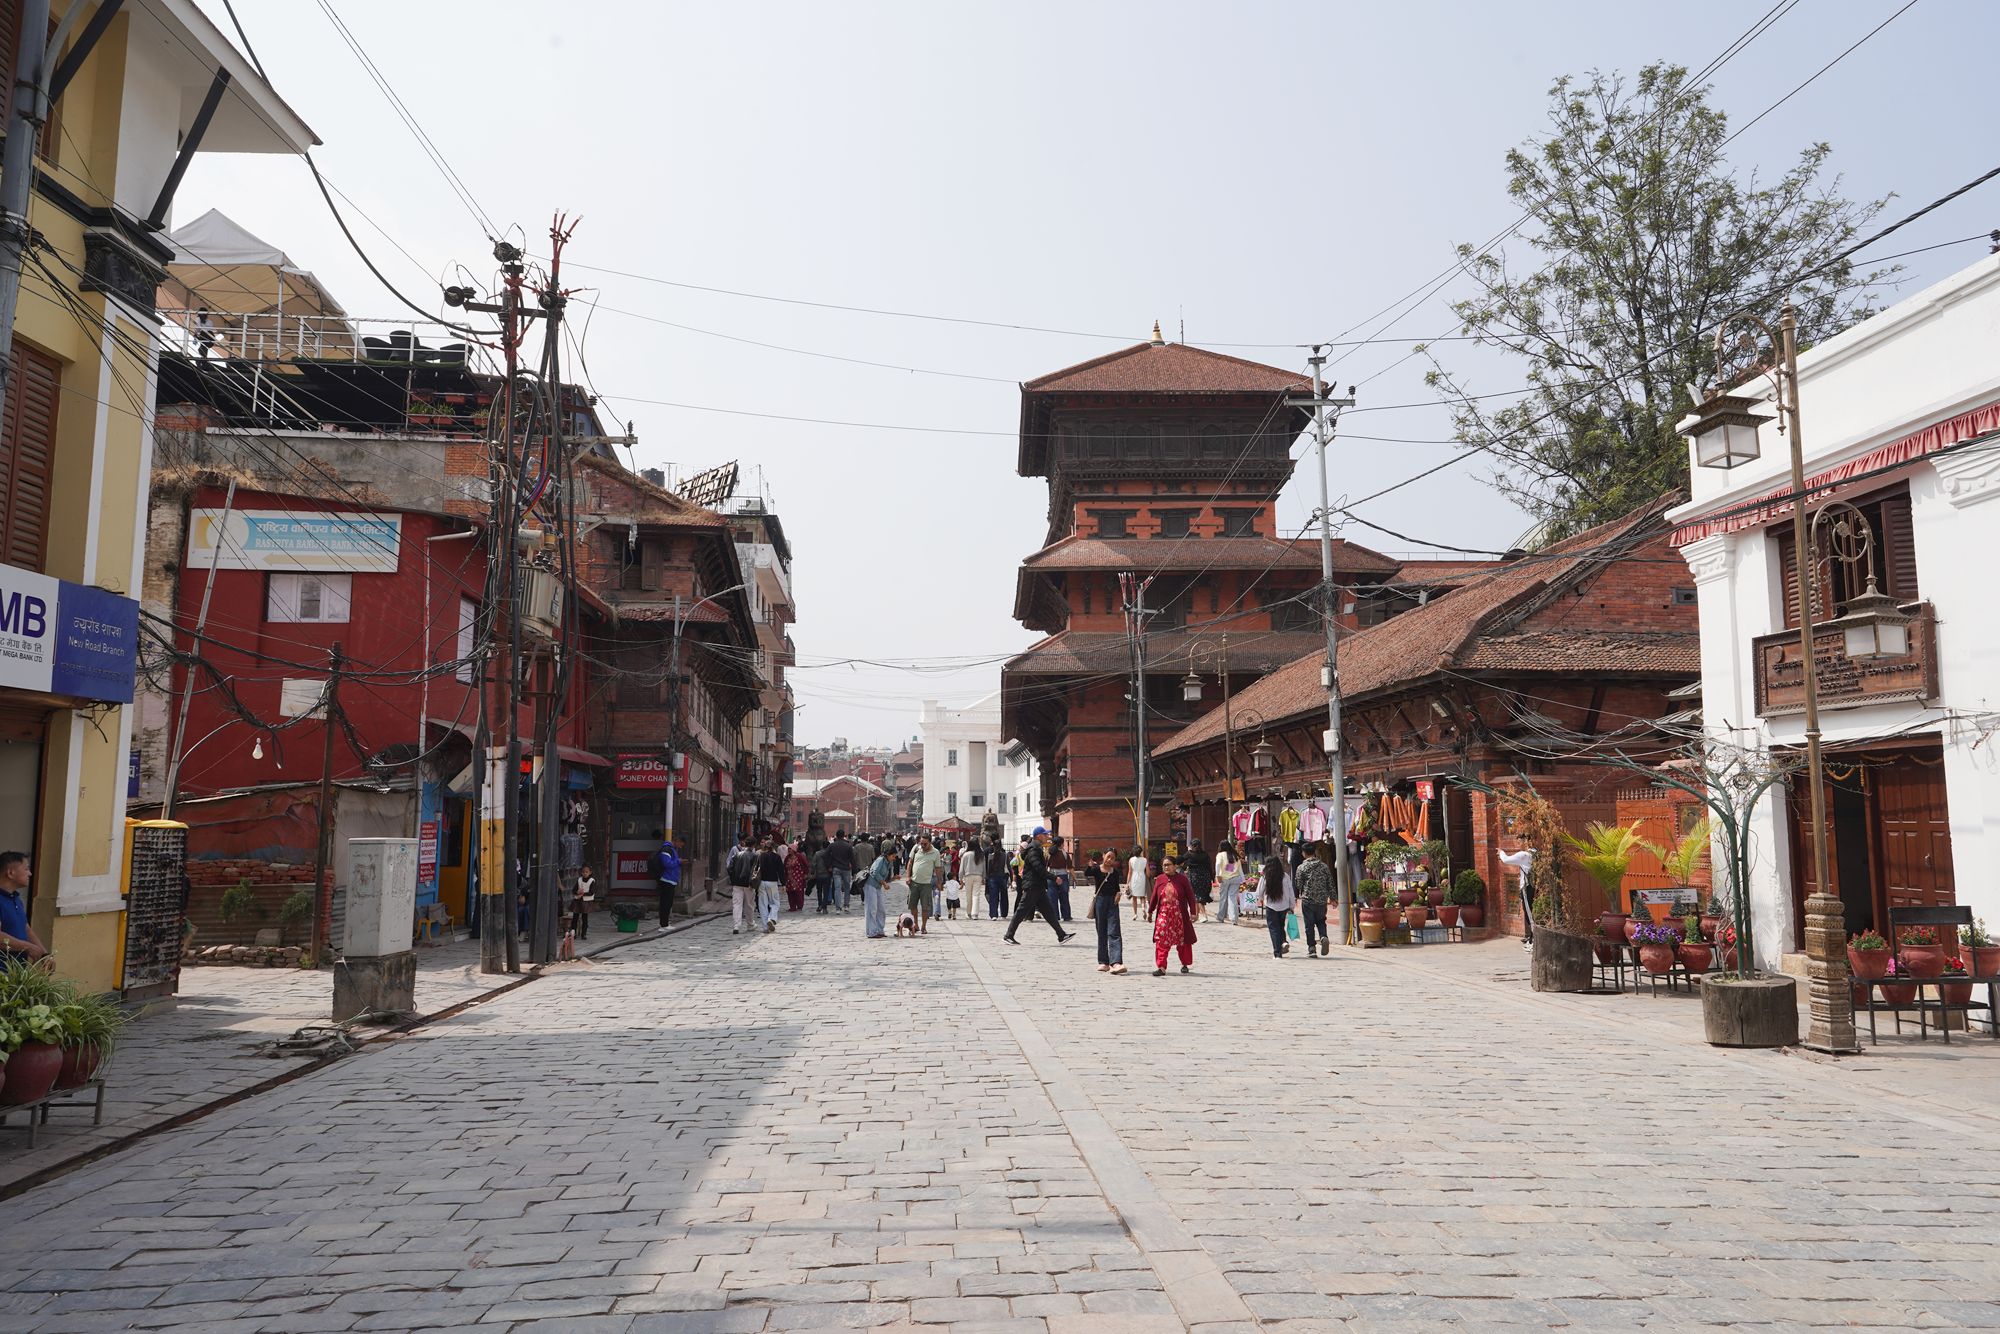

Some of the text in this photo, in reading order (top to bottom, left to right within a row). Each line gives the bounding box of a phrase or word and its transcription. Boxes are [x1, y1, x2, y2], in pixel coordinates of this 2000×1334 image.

[69, 636, 125, 656] New Road Branch
[3, 650, 18, 658] MEGA
[19, 652, 33, 660] BANK
